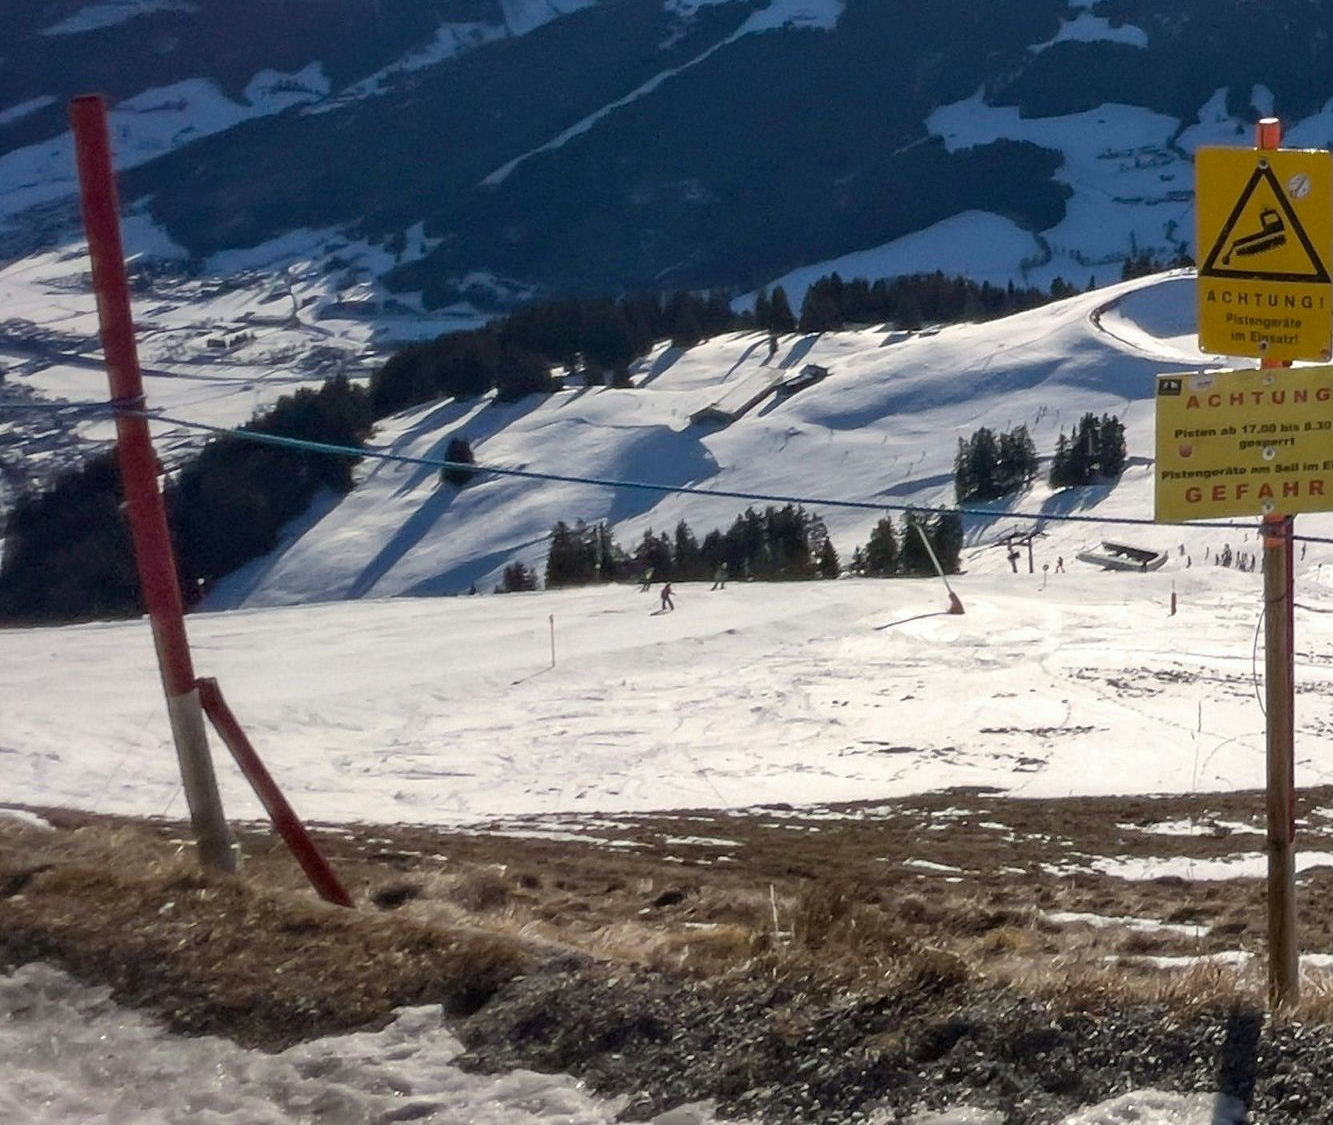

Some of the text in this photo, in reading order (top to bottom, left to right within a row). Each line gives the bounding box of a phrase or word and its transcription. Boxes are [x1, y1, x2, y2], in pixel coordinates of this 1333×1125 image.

[1207, 289, 1324, 309] ACHTUNG!
[1226, 312, 1302, 330] Pistengeräte
[1231, 331, 1246, 342] im
[1174, 428, 1217, 439] Pisten
[1221, 426, 1237, 436] ab
[1242, 423, 1277, 434] 17.00
[1281, 422, 1300, 433] bis
[1239, 437, 1296, 450] gesperrt
[1161, 466, 1247, 480] Pistengeräte
[1251, 466, 1270, 474] am
[1275, 462, 1299, 473] Seil
[1303, 461, 1319, 472] im
